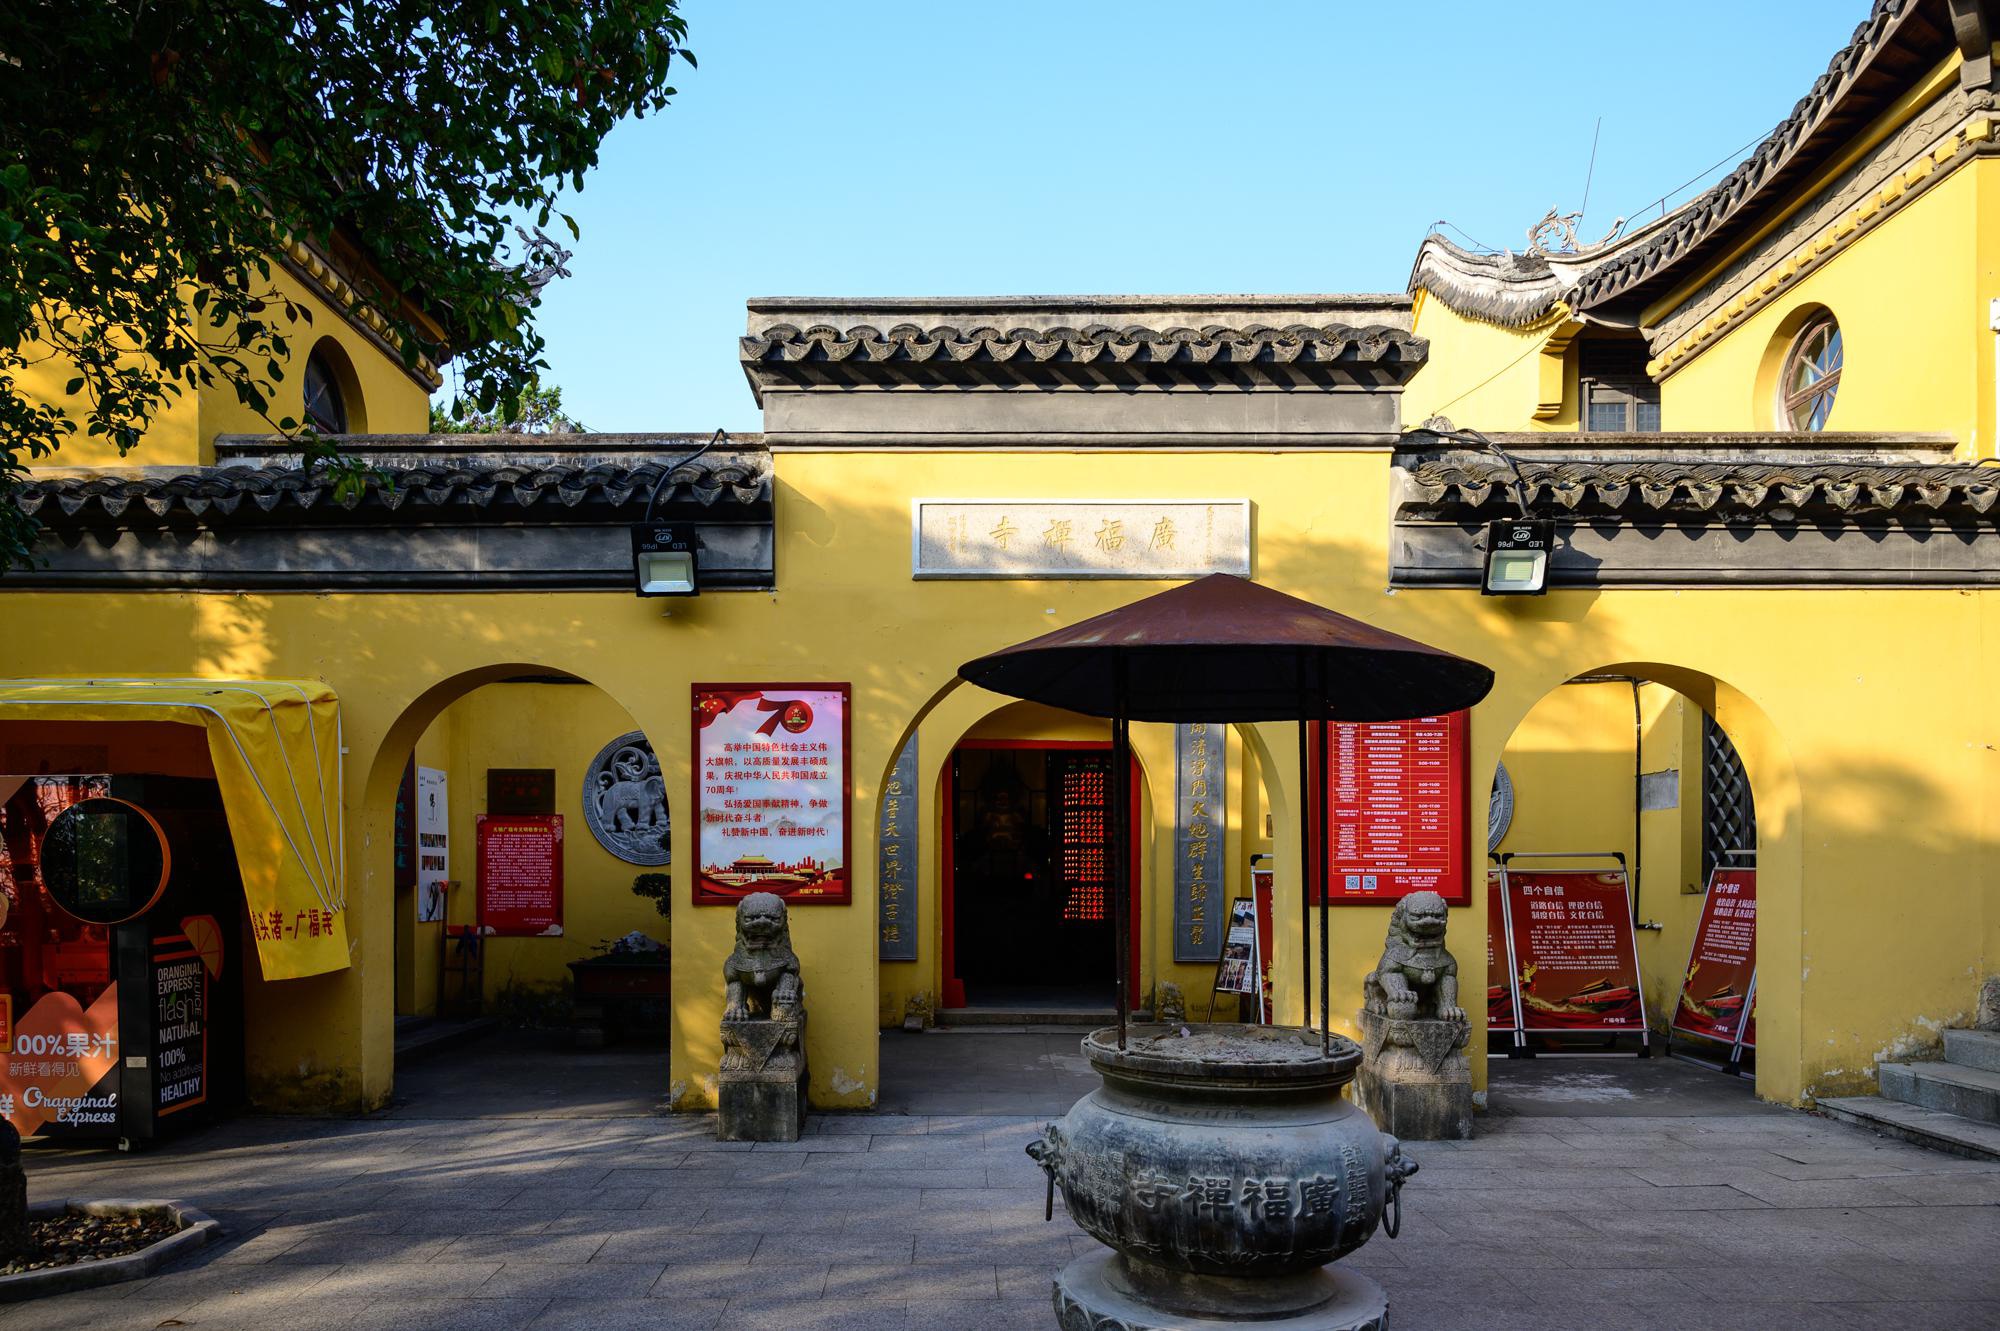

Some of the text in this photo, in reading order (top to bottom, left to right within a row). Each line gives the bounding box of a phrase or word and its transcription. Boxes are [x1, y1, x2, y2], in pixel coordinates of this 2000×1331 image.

[1497, 540, 1514, 548] IP66
[1528, 540, 1544, 548] LED
[724, 742, 828, 752] 高举中国特色社会主义伟
[1522, 885, 1565, 896] 四个自信
[1530, 900, 1604, 910] 道路自信 理论自信
[1531, 910, 1605, 920] 制度自信 文化自信
[157, 962, 203, 981] ORANGINAL
[157, 976, 194, 995] EXPRESS
[193, 976, 203, 1016] JUICE
[159, 1020, 201, 1044] NATURAL
[158, 1046, 186, 1068] 100%
[9, 1061, 80, 1077] 新鲜看得见
[159, 1069, 172, 1083] No
[23, 1086, 117, 1112] Oranginal
[160, 1076, 201, 1103] HEALTHY
[56, 1107, 116, 1127] Express
[1131, 1168, 1341, 1220] 廣福禪寺
